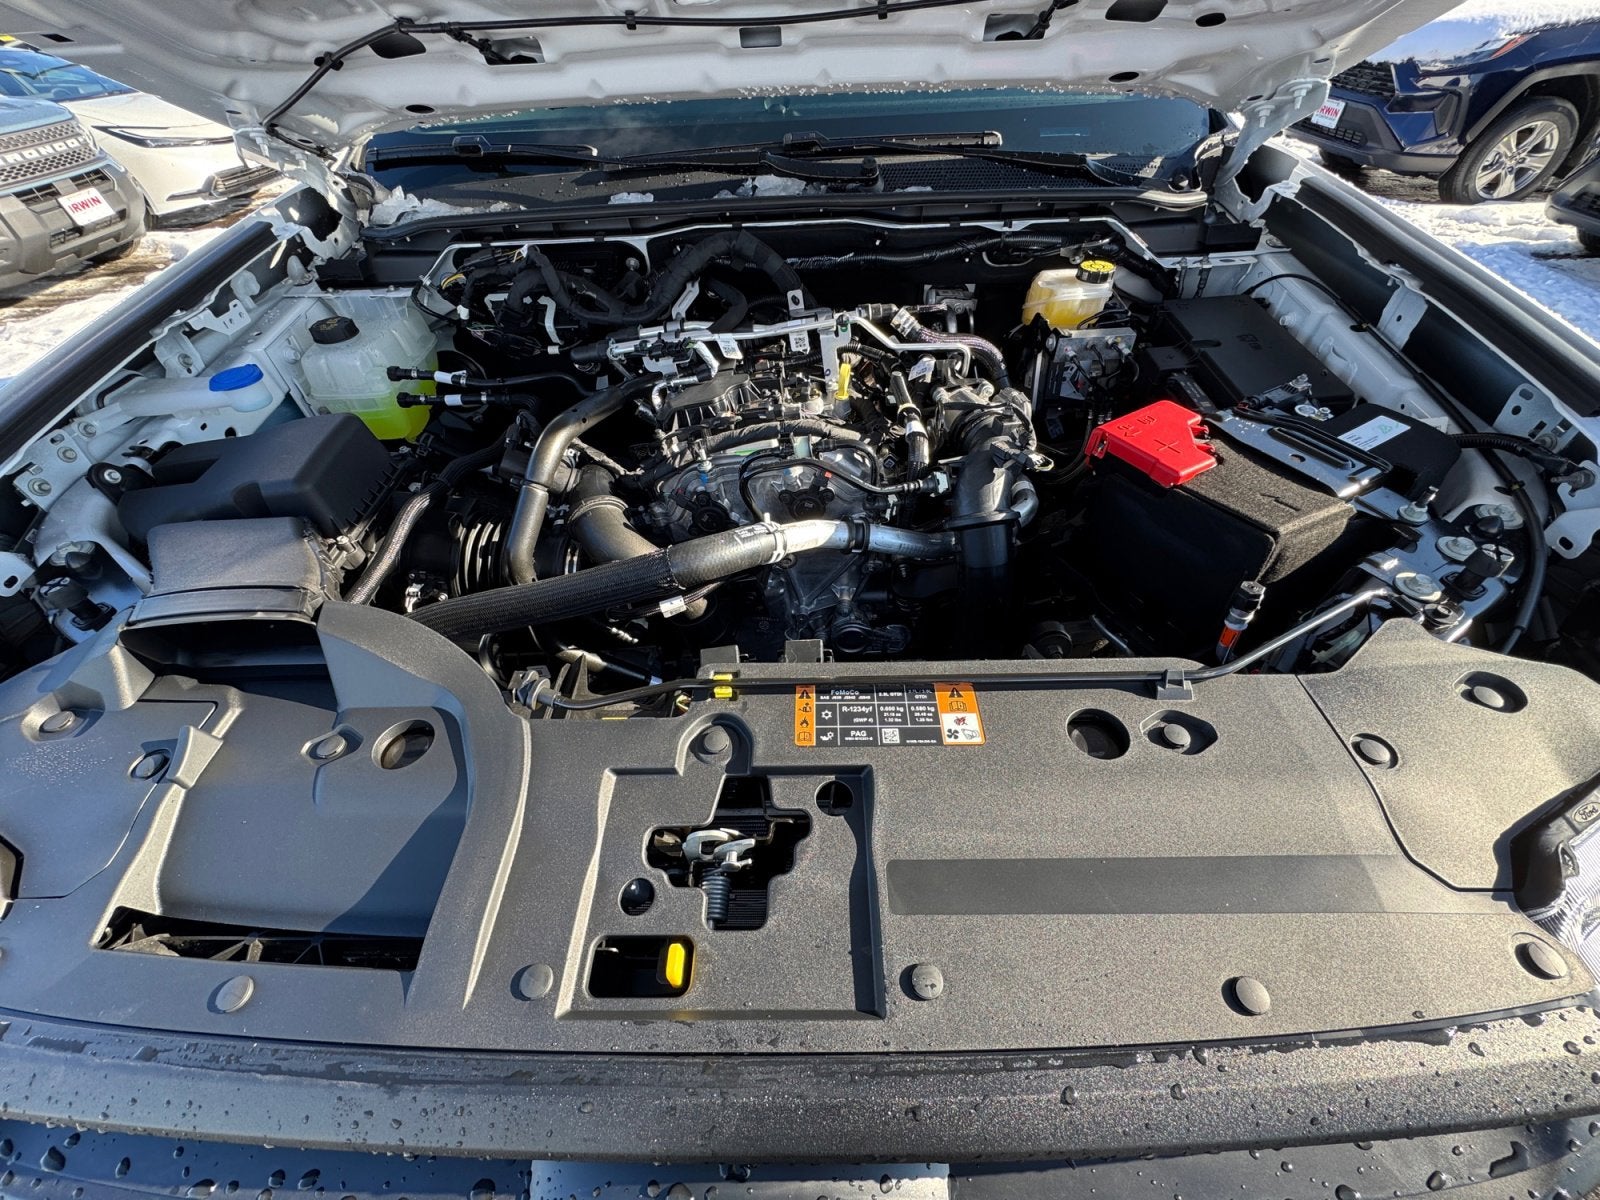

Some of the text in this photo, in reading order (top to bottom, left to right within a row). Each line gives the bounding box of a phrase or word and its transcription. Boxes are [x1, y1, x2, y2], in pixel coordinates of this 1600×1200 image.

[1317, 105, 1340, 117] RWIN
[0, 138, 80, 166] RONCO
[67, 196, 102, 214] IRWIN
[841, 705, 873, 713] R-1234yf
[1578, 805, 1599, 820] Ford
